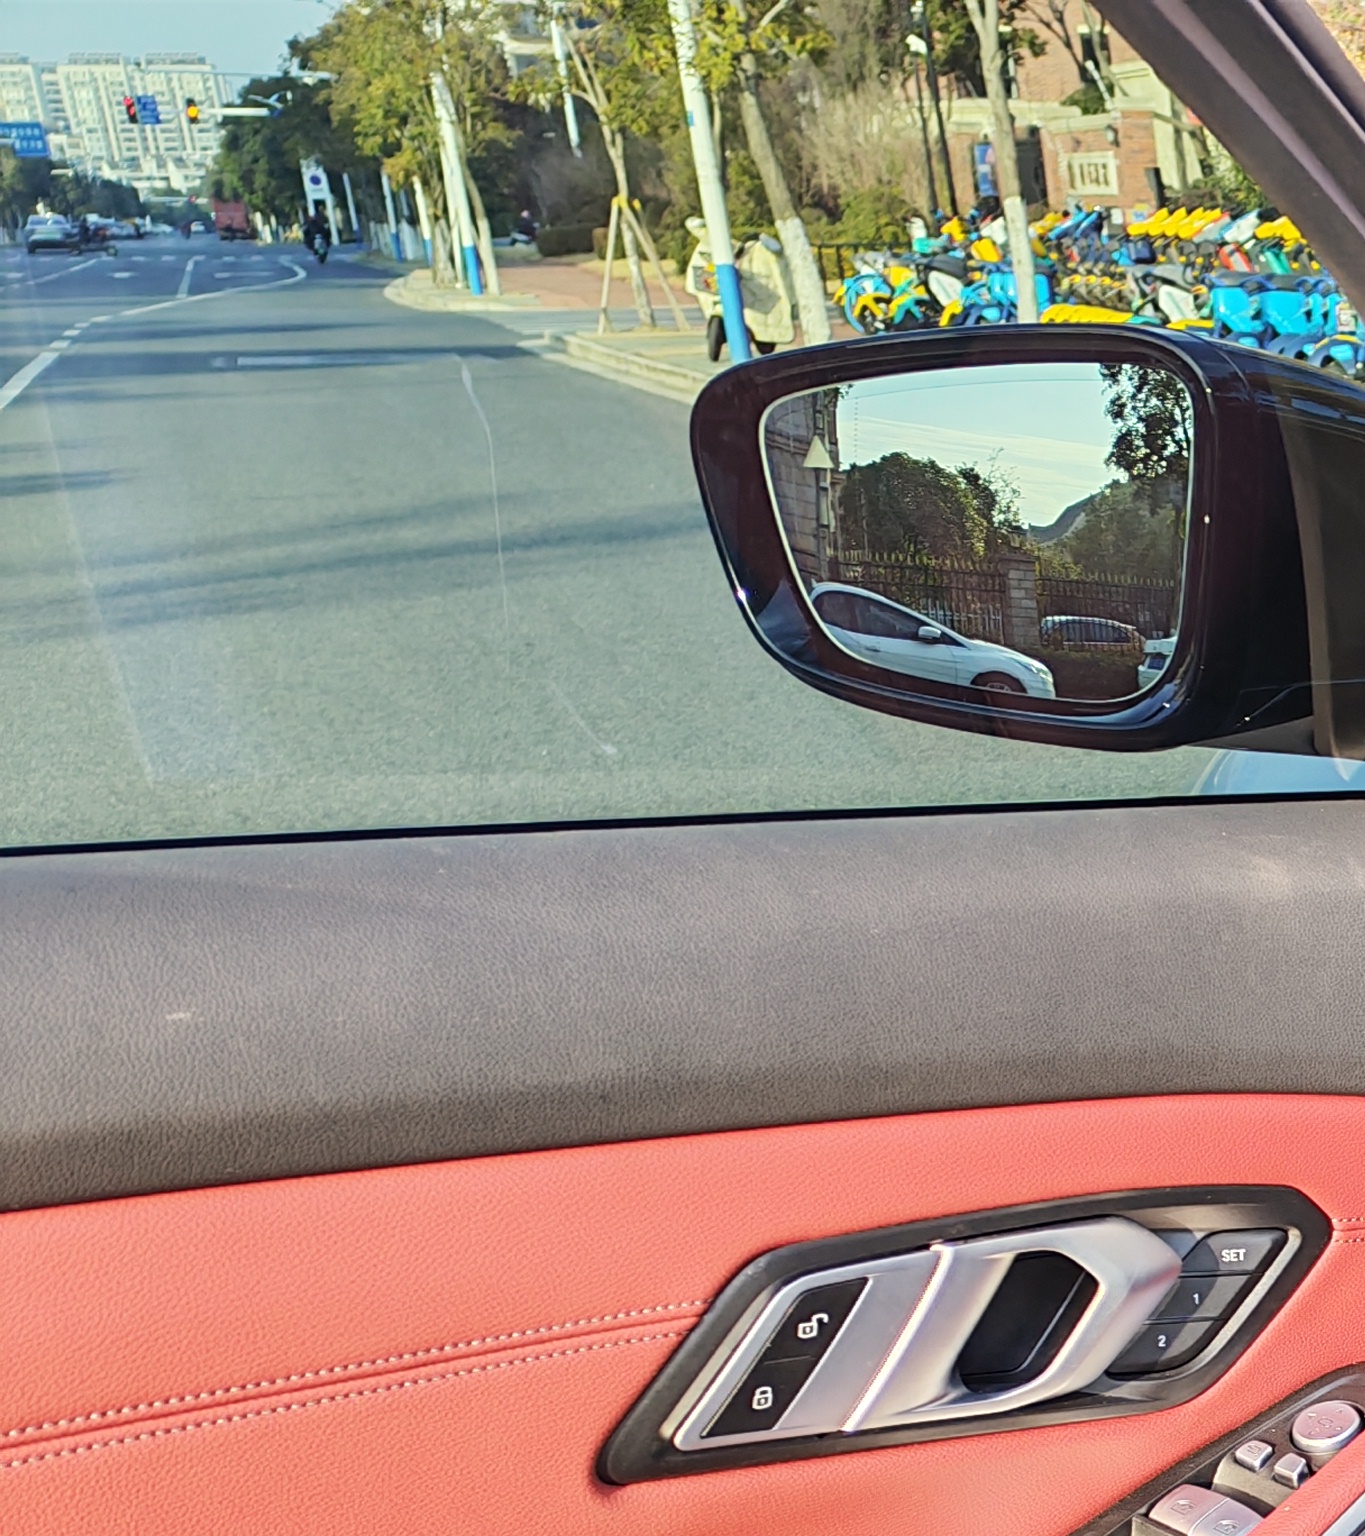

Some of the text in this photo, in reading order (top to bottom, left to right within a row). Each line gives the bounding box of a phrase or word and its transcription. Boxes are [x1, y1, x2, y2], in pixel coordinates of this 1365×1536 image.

[1221, 1248, 1246, 1262] SET
[1193, 1293, 1200, 1305] 1
[1157, 1334, 1167, 1347] 2
